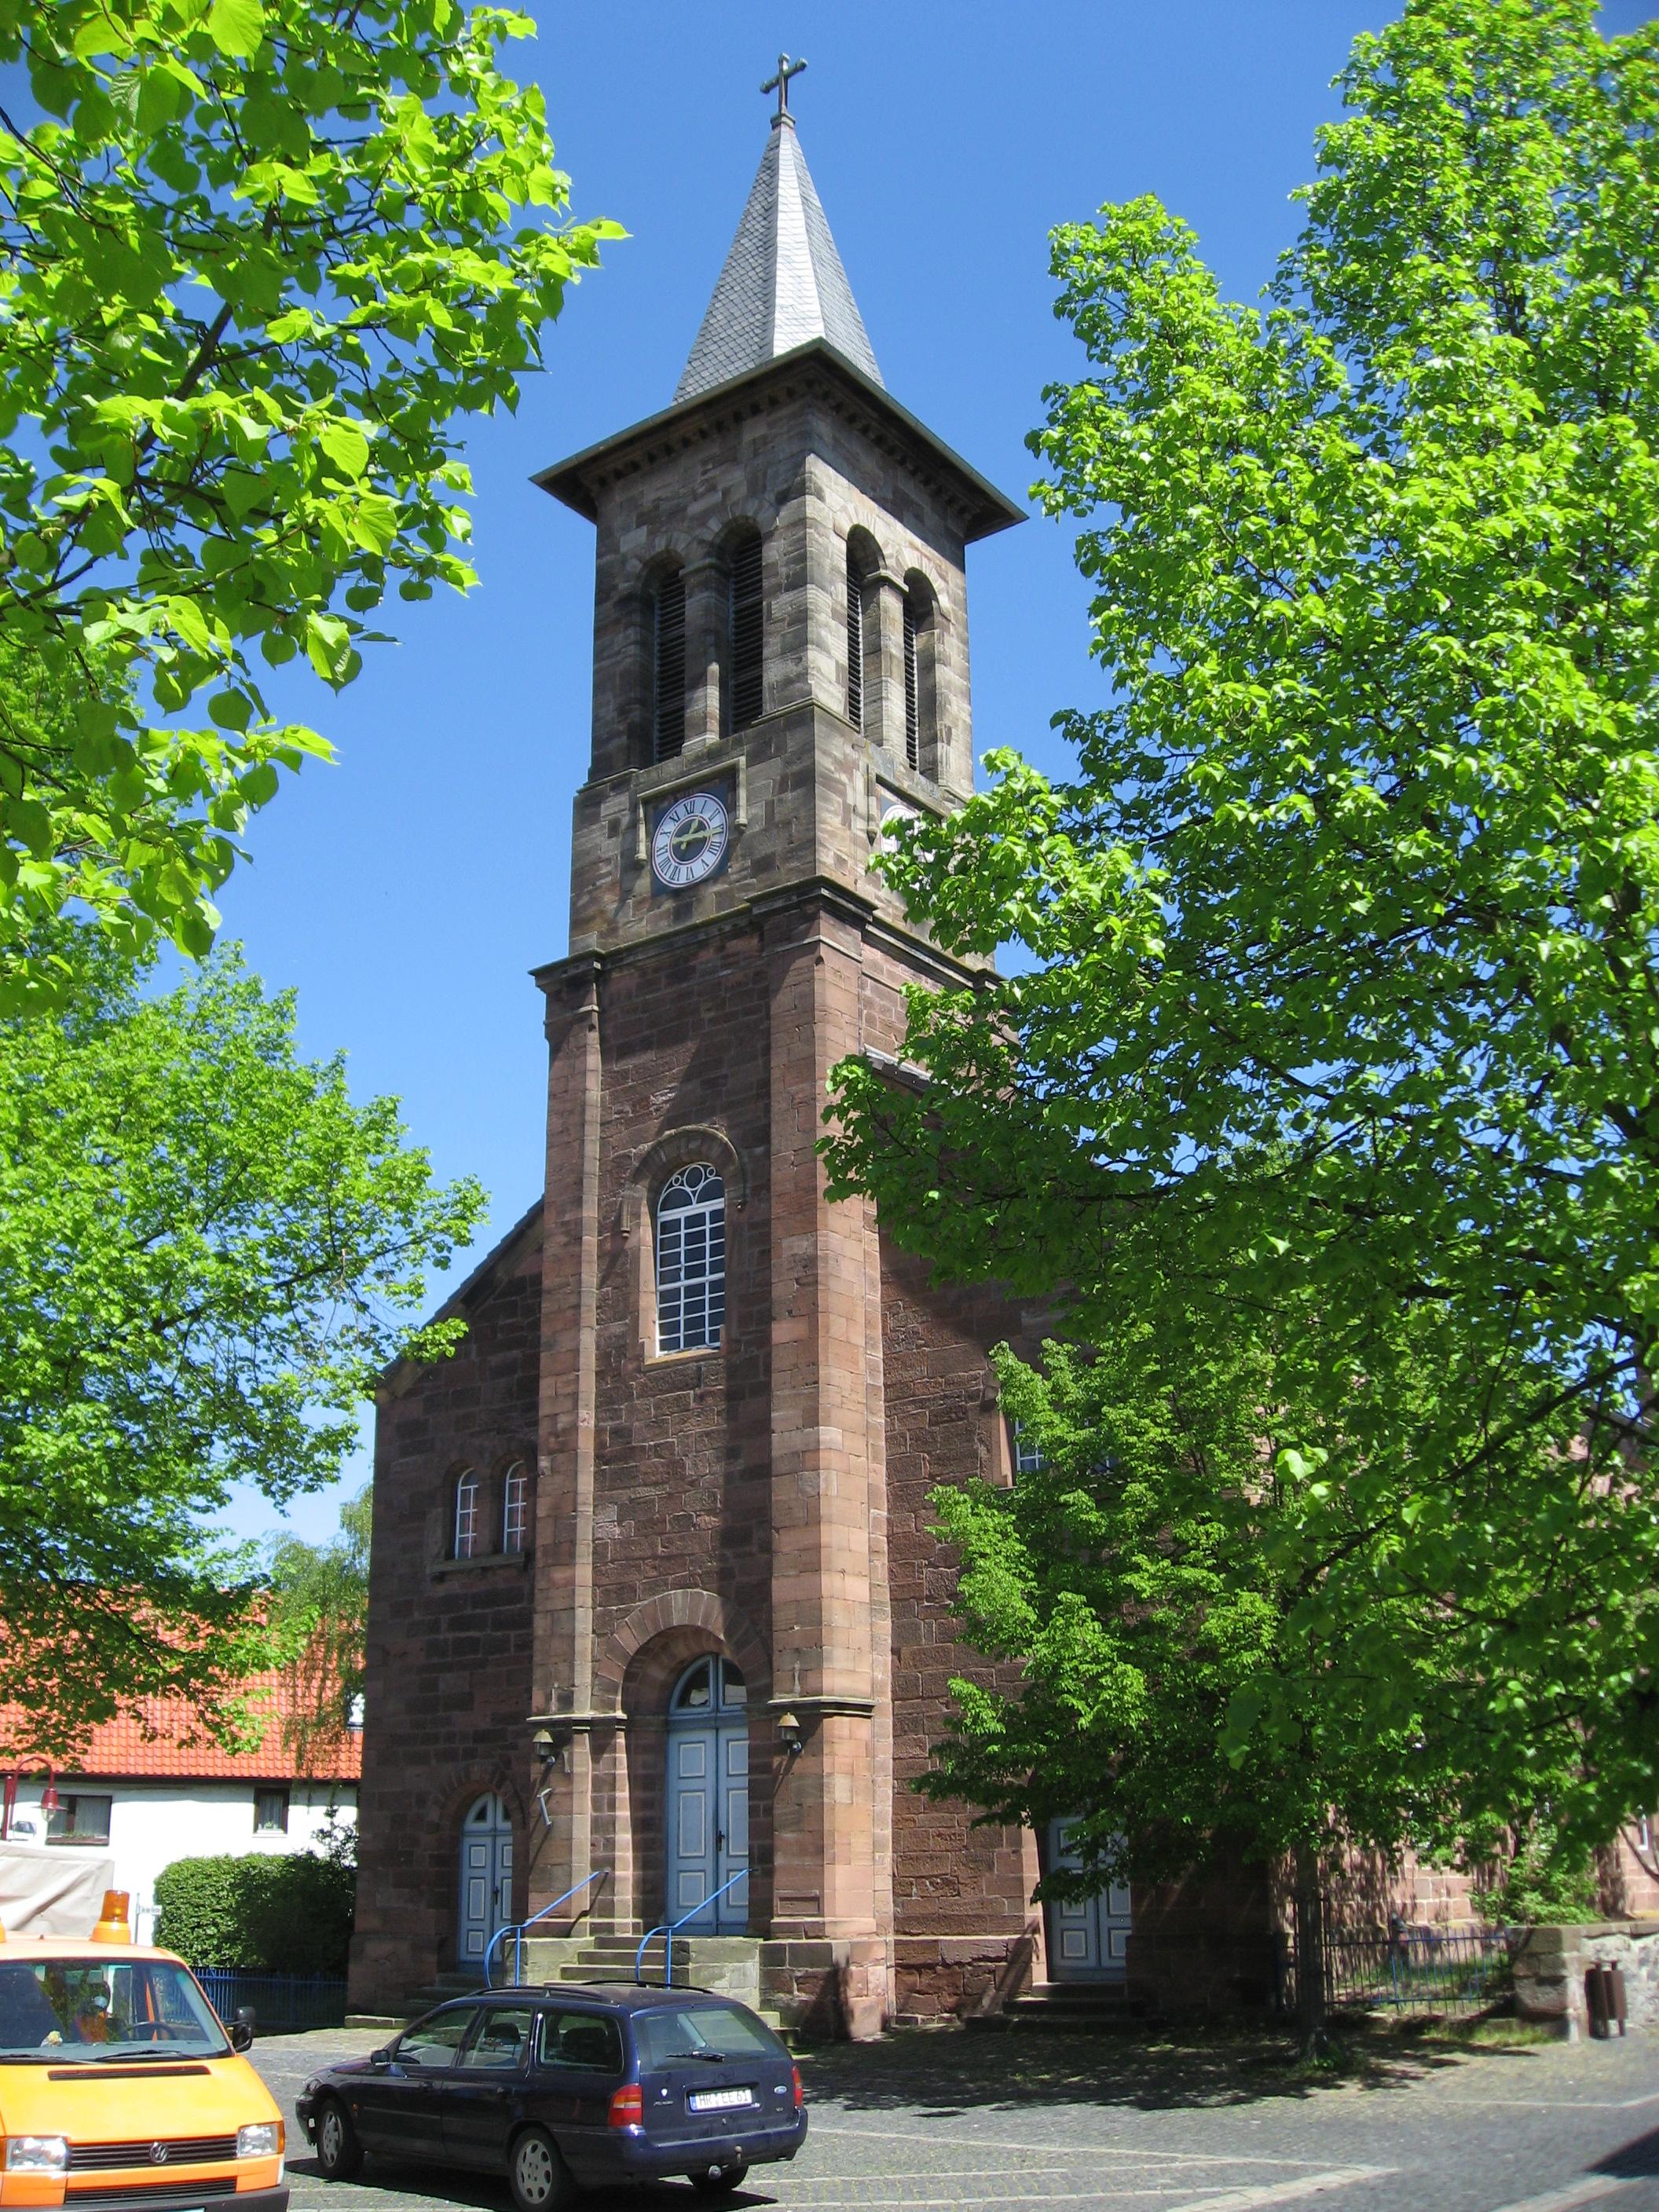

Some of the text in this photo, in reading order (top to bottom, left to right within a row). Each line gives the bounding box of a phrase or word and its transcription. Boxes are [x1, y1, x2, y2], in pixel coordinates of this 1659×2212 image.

[683, 800, 696, 814] XII
[700, 800, 707, 814] I
[669, 810, 681, 826] XI
[709, 808, 721, 822] II
[660, 828, 672, 837] X
[657, 844, 668, 856] IX
[701, 859, 709, 871] V
[669, 866, 681, 881] VII
[686, 866, 695, 881] VI
